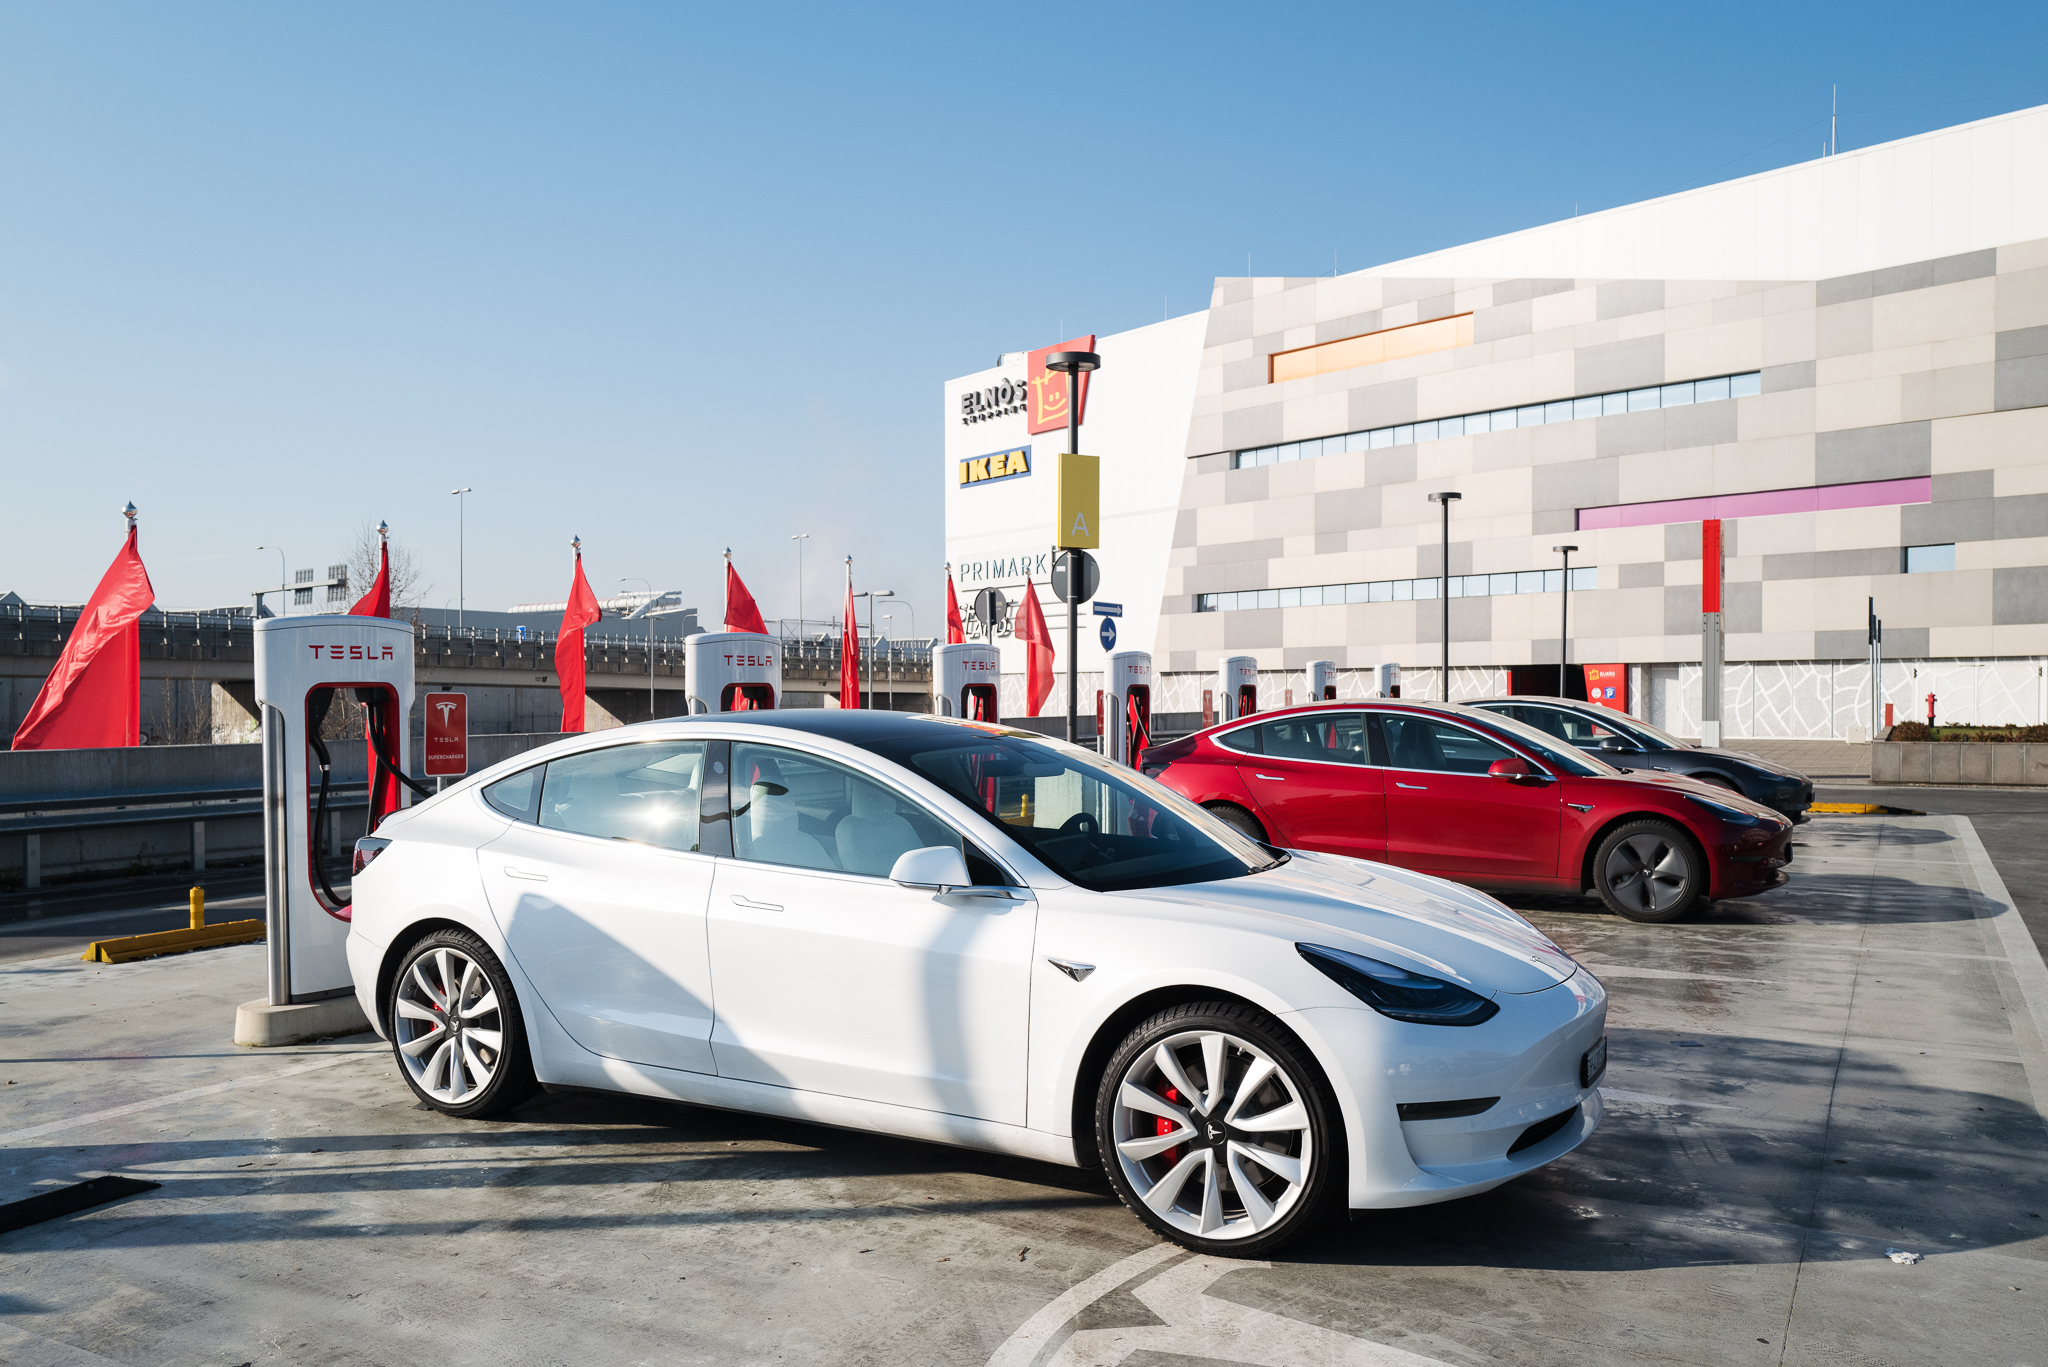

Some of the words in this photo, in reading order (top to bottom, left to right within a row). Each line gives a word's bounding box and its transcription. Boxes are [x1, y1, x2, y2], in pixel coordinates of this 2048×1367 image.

[959, 450, 1029, 485] IKEA
[1071, 512, 1090, 537] A
[960, 553, 1047, 582] PRIMARK
[308, 644, 394, 660] TESLA
[723, 655, 773, 666] TESLA
[962, 661, 996, 671] TESLA
[1128, 665, 1150, 674] TESLA
[427, 753, 465, 761] SUPERCHARGER
